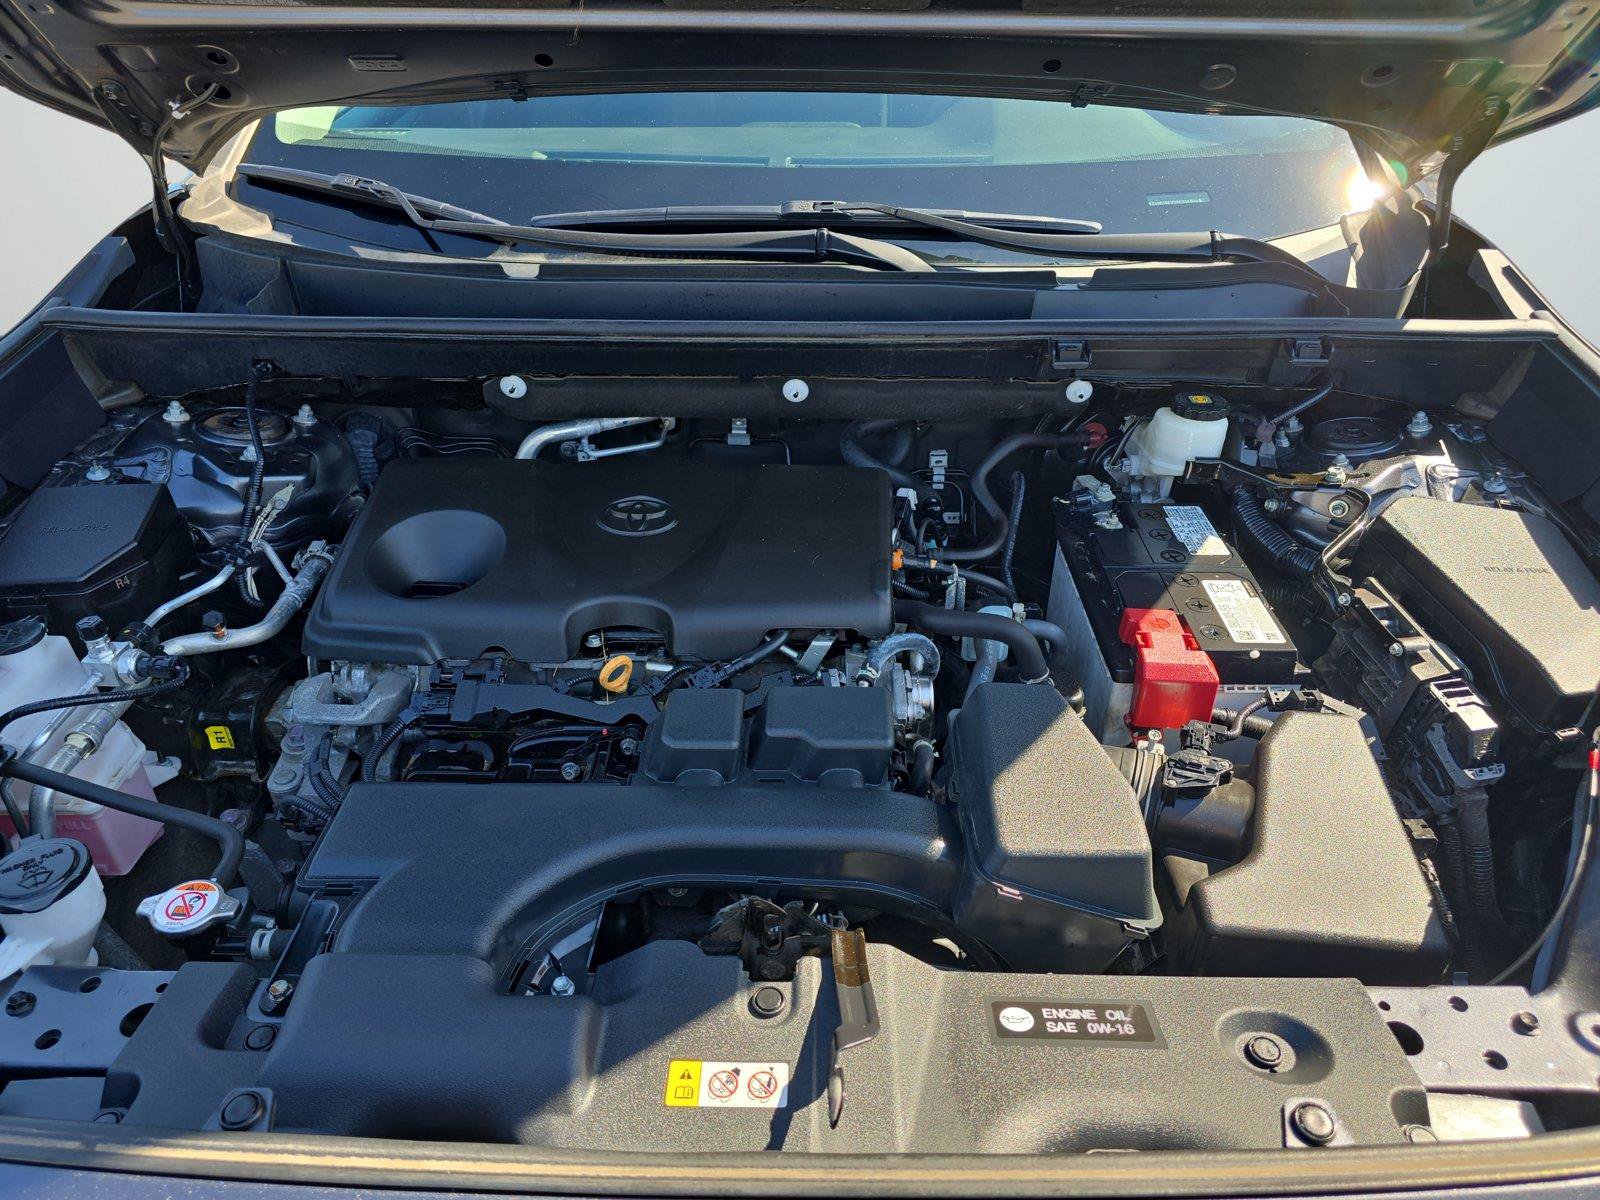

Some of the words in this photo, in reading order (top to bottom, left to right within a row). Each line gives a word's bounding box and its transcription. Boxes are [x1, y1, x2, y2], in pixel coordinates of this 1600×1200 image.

[114, 575, 130, 590] R4
[213, 731, 226, 743] R1
[1041, 1008, 1098, 1020] ENGINE
[1104, 1009, 1132, 1021] OIL
[1045, 1021, 1079, 1034] SAE
[1086, 1022, 1136, 1035] 0W-16
